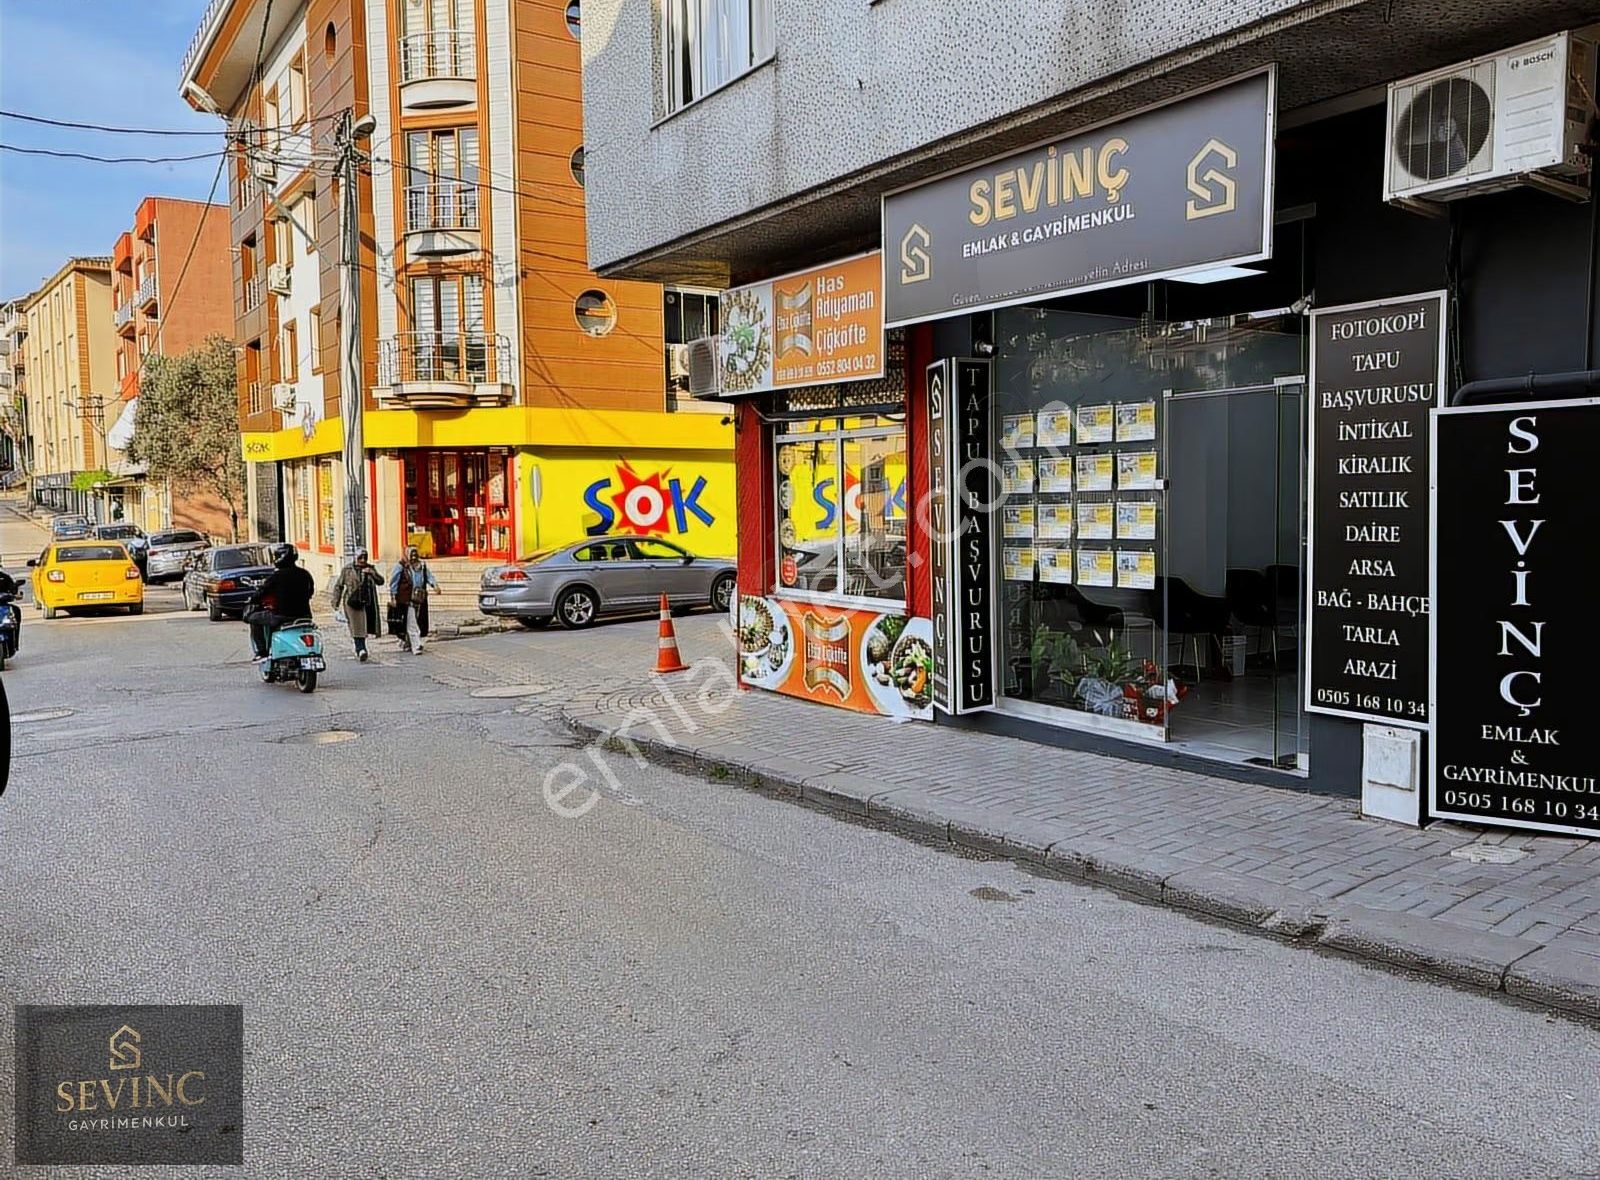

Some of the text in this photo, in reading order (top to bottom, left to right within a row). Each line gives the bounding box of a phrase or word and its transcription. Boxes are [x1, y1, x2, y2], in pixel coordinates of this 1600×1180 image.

[1523, 51, 1554, 66] BOSCH
[968, 136, 1131, 227] SEVİNÇ
[962, 204, 1136, 260] EMLAK & GAYRİMENKUL
[816, 275, 844, 295] Has
[1331, 308, 1427, 341] FOTOKOPİ
[1352, 351, 1400, 372] TAPU
[1321, 383, 1434, 411] BAŞVURUSU
[1338, 419, 1413, 441] İNTİKAL
[1338, 454, 1413, 475] KİRALIK
[1339, 490, 1409, 508] SATILIK
[965, 367, 984, 702] TAPU BAŞVURUSU
[1345, 521, 1401, 543] DAİRE
[1348, 558, 1396, 577] ARSA
[1496, 415, 1547, 717] SEVİNÇ
[1317, 588, 1352, 608] BAĞ
[1367, 593, 1431, 618] BAHÇE
[1342, 624, 1400, 646] TARLA
[1343, 658, 1397, 680] ARAZİ
[1317, 687, 1425, 717] 0505 168 10 34
[1481, 724, 1560, 746] EMLAK
[1510, 749, 1529, 766] &
[1442, 764, 1600, 796] GAYRİMENKUL
[1444, 789, 1599, 822] 0505 168 10 34
